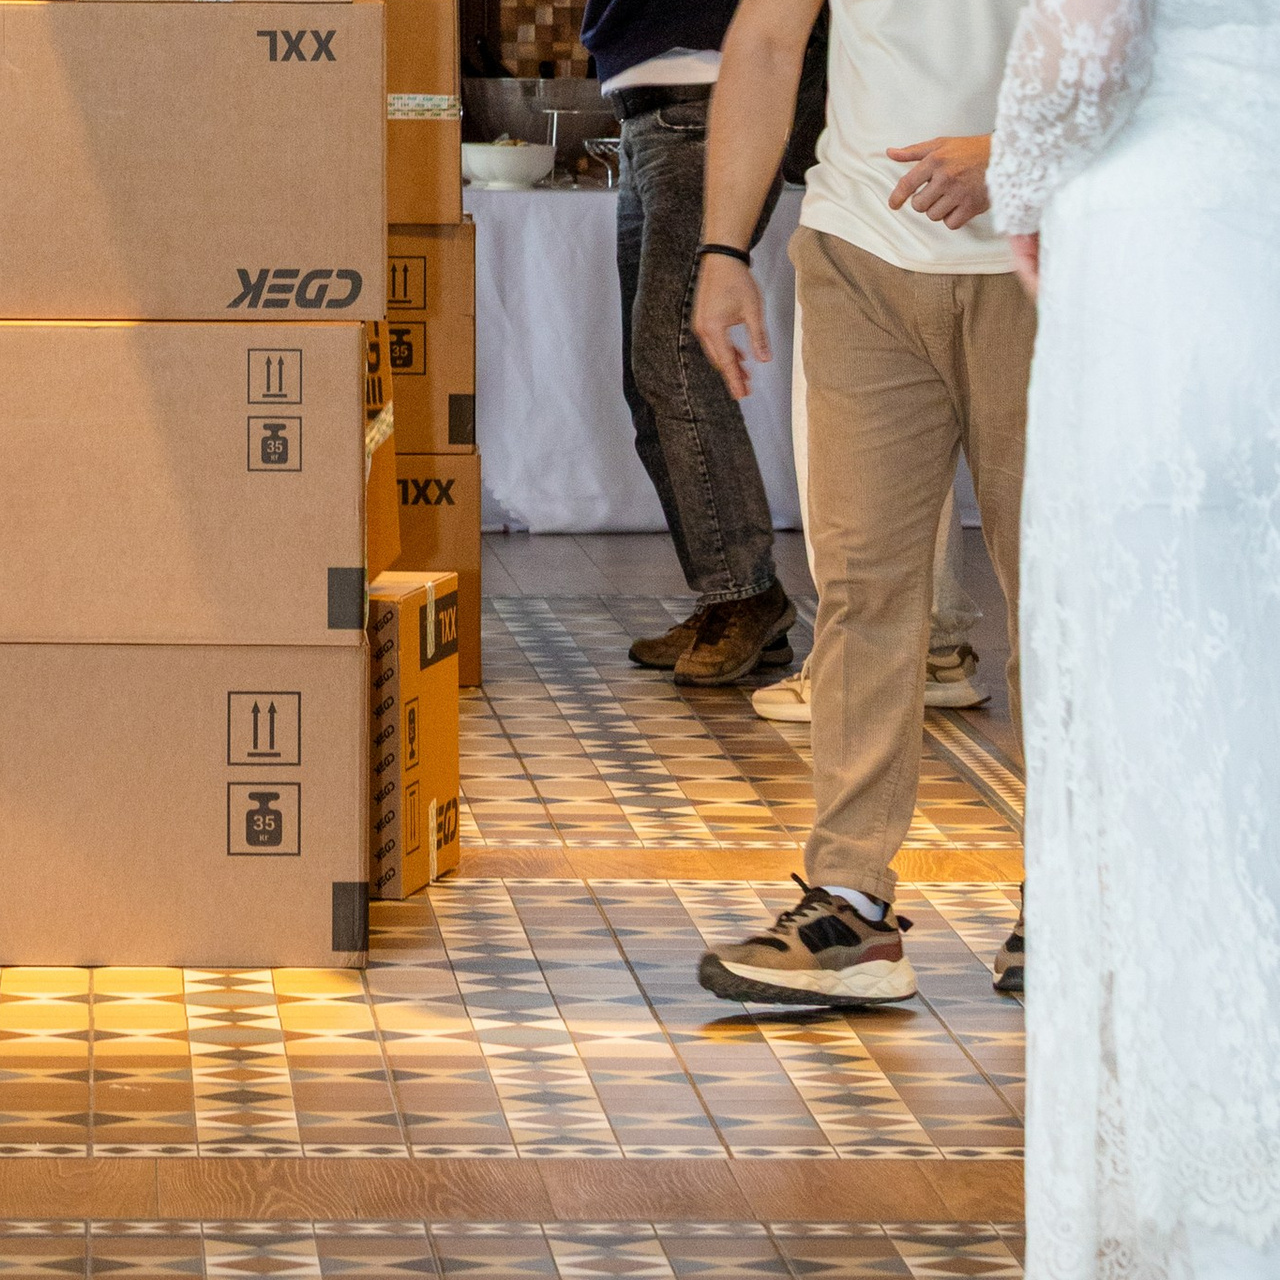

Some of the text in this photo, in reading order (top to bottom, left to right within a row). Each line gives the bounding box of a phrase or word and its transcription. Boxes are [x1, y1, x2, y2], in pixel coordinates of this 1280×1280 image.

[257, 30, 336, 61] XXL
[227, 269, 362, 308] CDEK
[392, 344, 408, 357] 35
[266, 441, 282, 453] 35
[253, 815, 274, 831] 35
[436, 797, 458, 851] CDE
